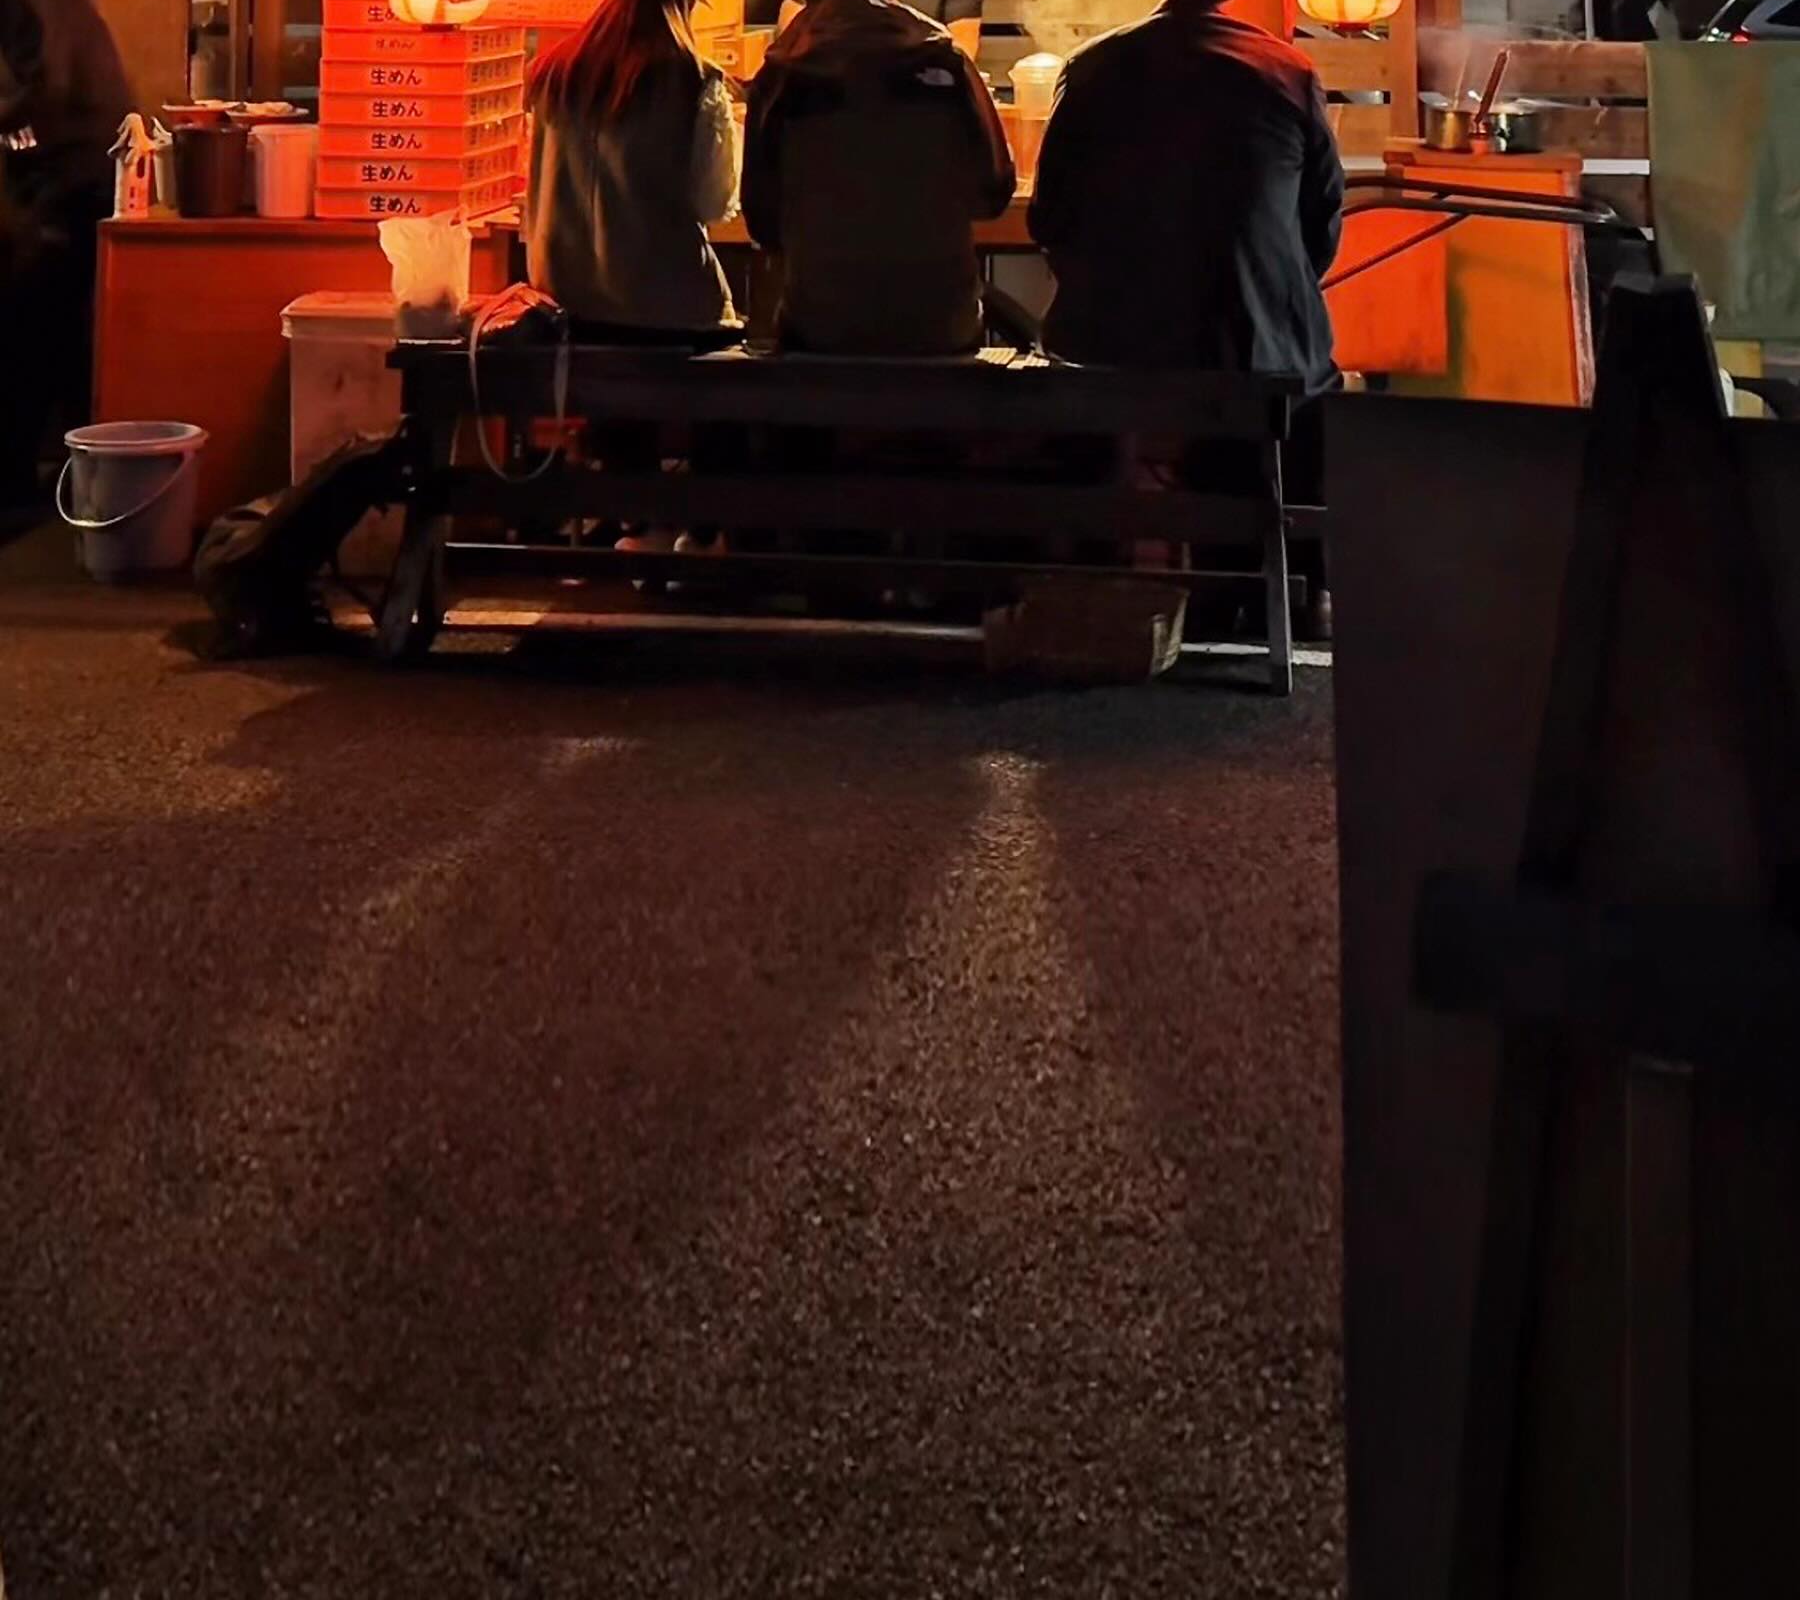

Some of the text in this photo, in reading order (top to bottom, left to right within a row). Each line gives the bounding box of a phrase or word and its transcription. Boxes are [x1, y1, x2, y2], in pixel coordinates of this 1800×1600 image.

[371, 68, 422, 86] 生めん
[372, 101, 423, 118] 生めん
[371, 133, 422, 150] 生めん
[361, 164, 413, 183] 生めん
[369, 195, 421, 214] 生めん
